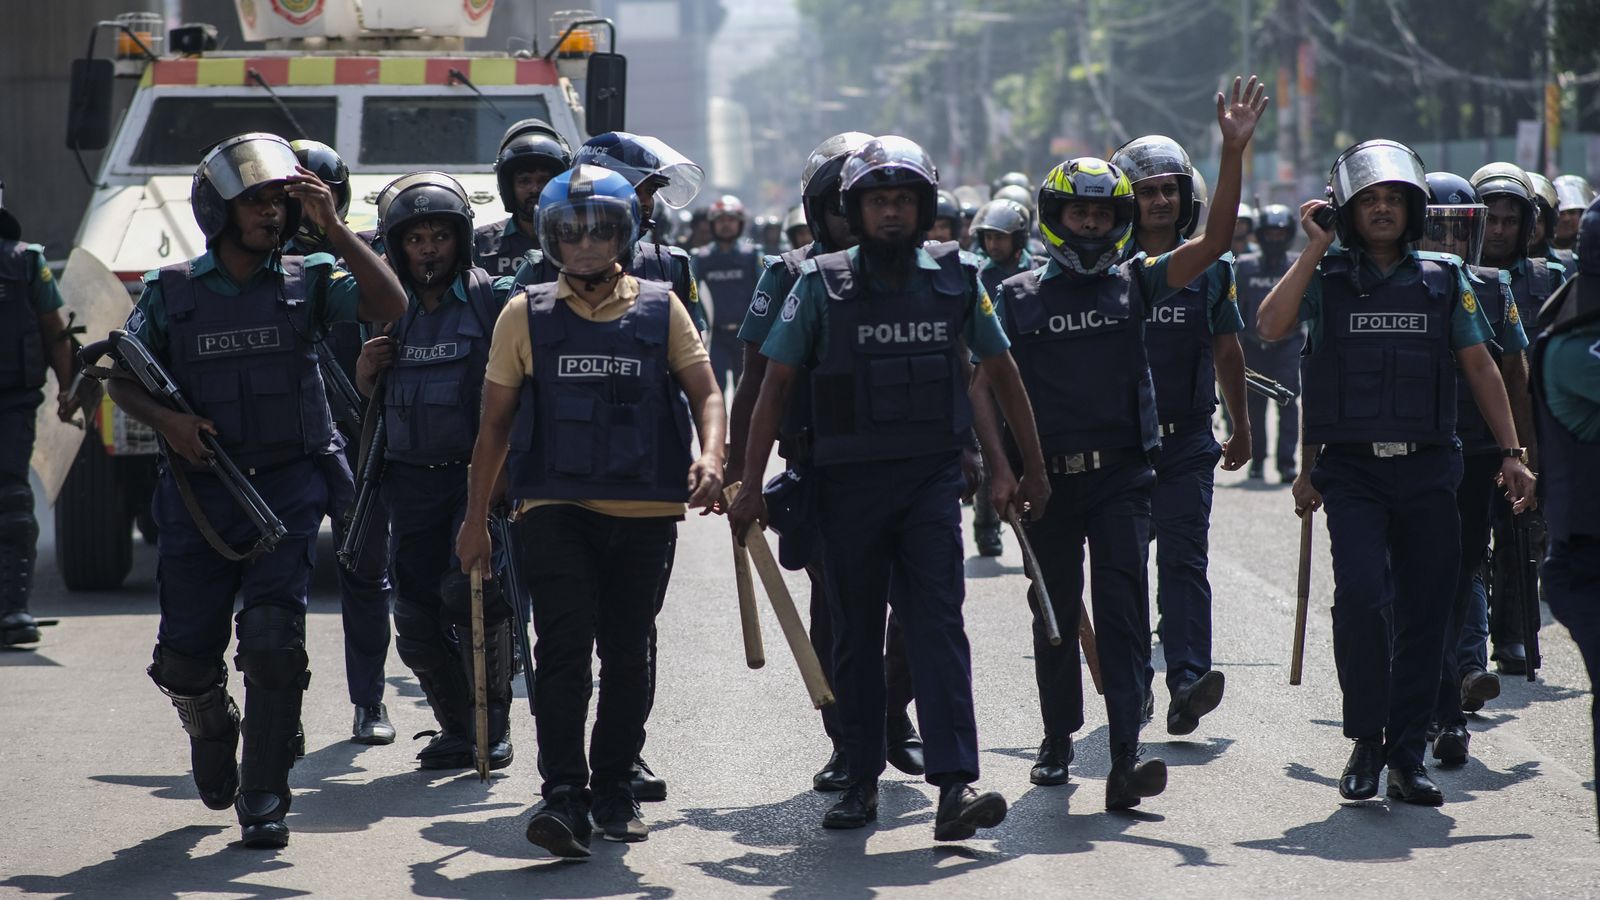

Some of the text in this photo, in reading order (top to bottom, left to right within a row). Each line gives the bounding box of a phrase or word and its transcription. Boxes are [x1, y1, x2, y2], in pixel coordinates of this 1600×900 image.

[1035, 309, 1119, 335] OLIC
[1357, 316, 1420, 329] POLICE
[205, 330, 271, 350] POLCE
[857, 321, 949, 345] POLICE
[406, 345, 446, 360] POLICE
[566, 358, 632, 376] POLICE
